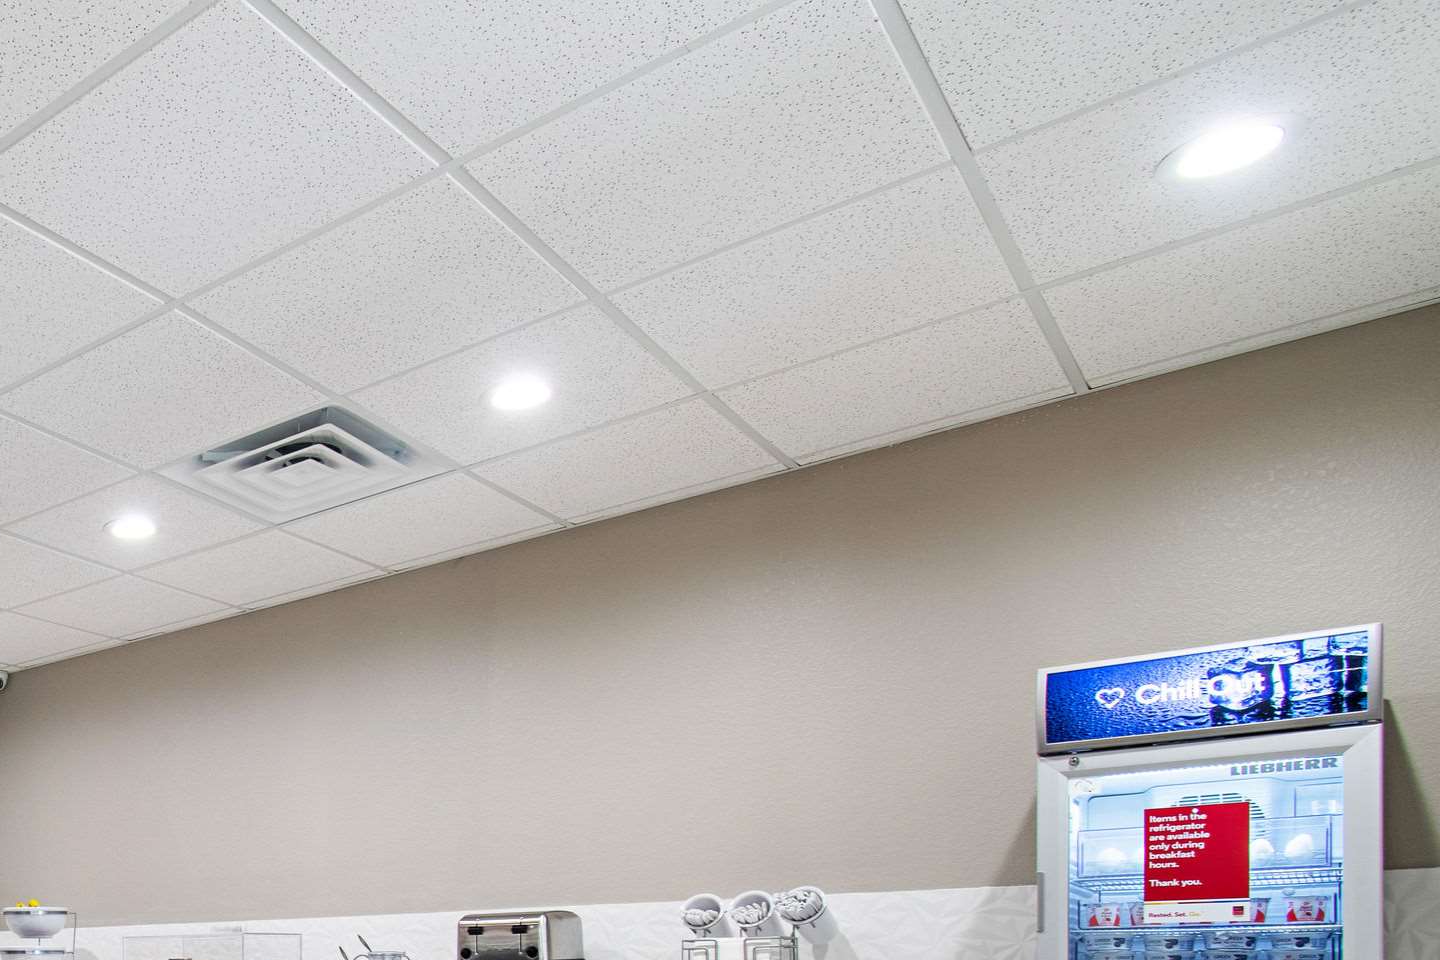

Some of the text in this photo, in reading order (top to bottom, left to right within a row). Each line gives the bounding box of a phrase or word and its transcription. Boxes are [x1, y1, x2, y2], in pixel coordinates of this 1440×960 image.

[1135, 671, 1266, 704] Chill Out
[1230, 757, 1338, 776] LIEBHERR
[1149, 812, 1207, 823] Items in the
[1149, 823, 1206, 832] refrigerator
[1166, 831, 1210, 841] available
[1149, 841, 1205, 851] only during
[1149, 850, 1196, 860] breakfast
[1149, 861, 1179, 869] hours.
[1148, 878, 1203, 887] Thank you.
